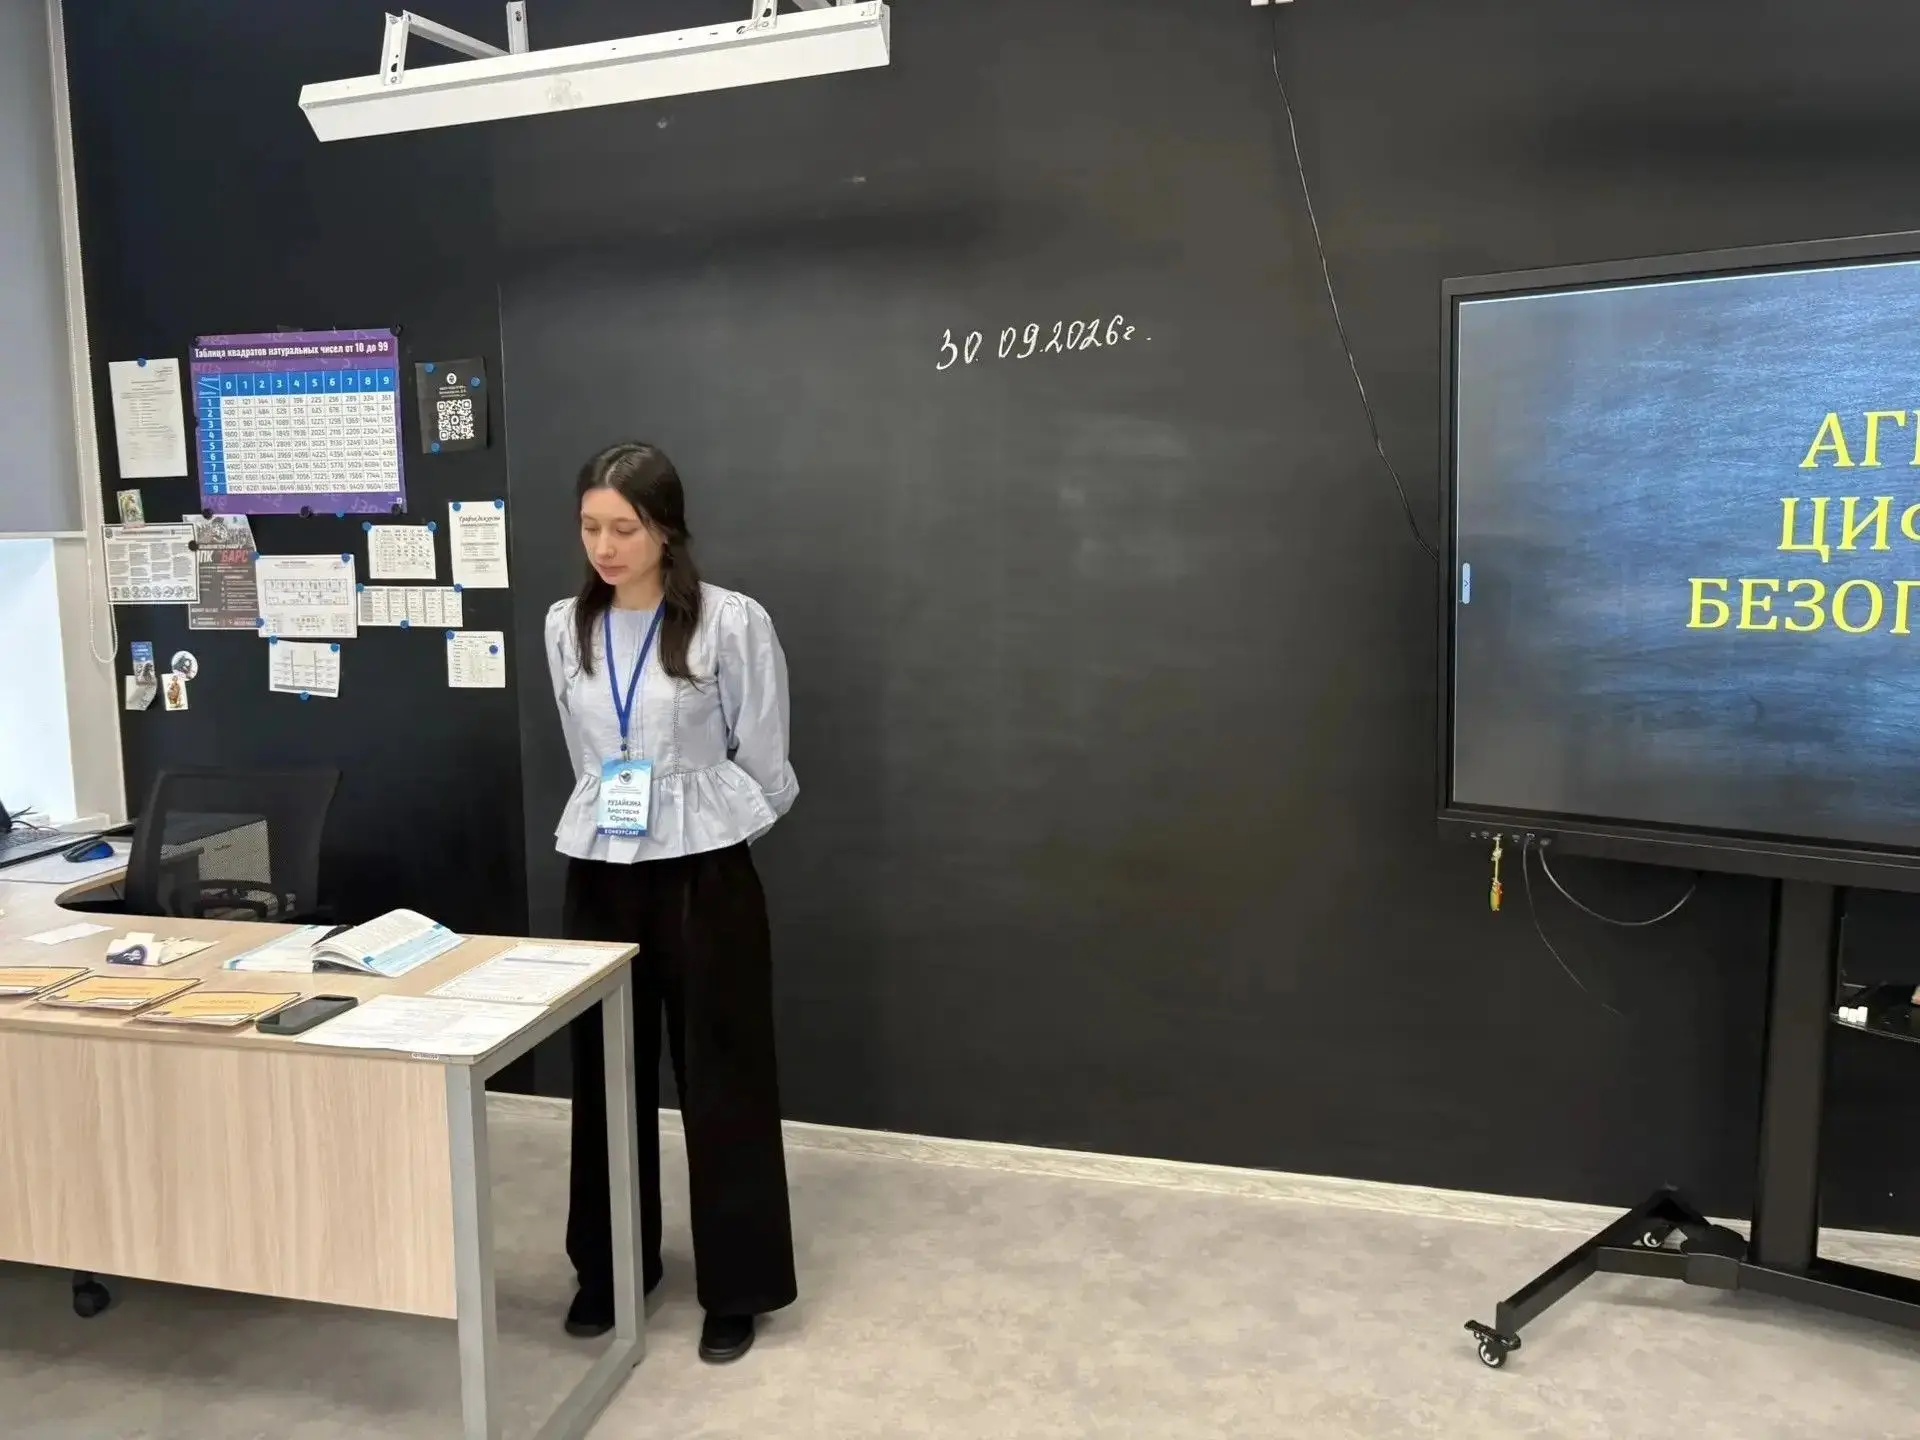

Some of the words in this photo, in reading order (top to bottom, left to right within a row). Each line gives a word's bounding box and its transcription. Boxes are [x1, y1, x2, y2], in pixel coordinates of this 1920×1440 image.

[194, 348, 226, 358] Таблица
[227, 348, 267, 358] квадратов
[268, 346, 319, 357] натуральных
[320, 345, 343, 354] чисел
[344, 345, 354, 353] от
[355, 342, 365, 353] 10
[366, 344, 377, 353] до
[377, 341, 389, 352] 99
[226, 382, 232, 390] 0
[243, 381, 248, 389] 1
[259, 380, 265, 388] 2
[276, 380, 283, 388] 3
[294, 379, 300, 388] 4
[312, 379, 318, 388] 5
[329, 378, 336, 386] 6
[347, 378, 353, 386] 7
[364, 377, 372, 386] 8
[383, 376, 390, 385] 9
[1798, 411, 1920, 468] АГ
